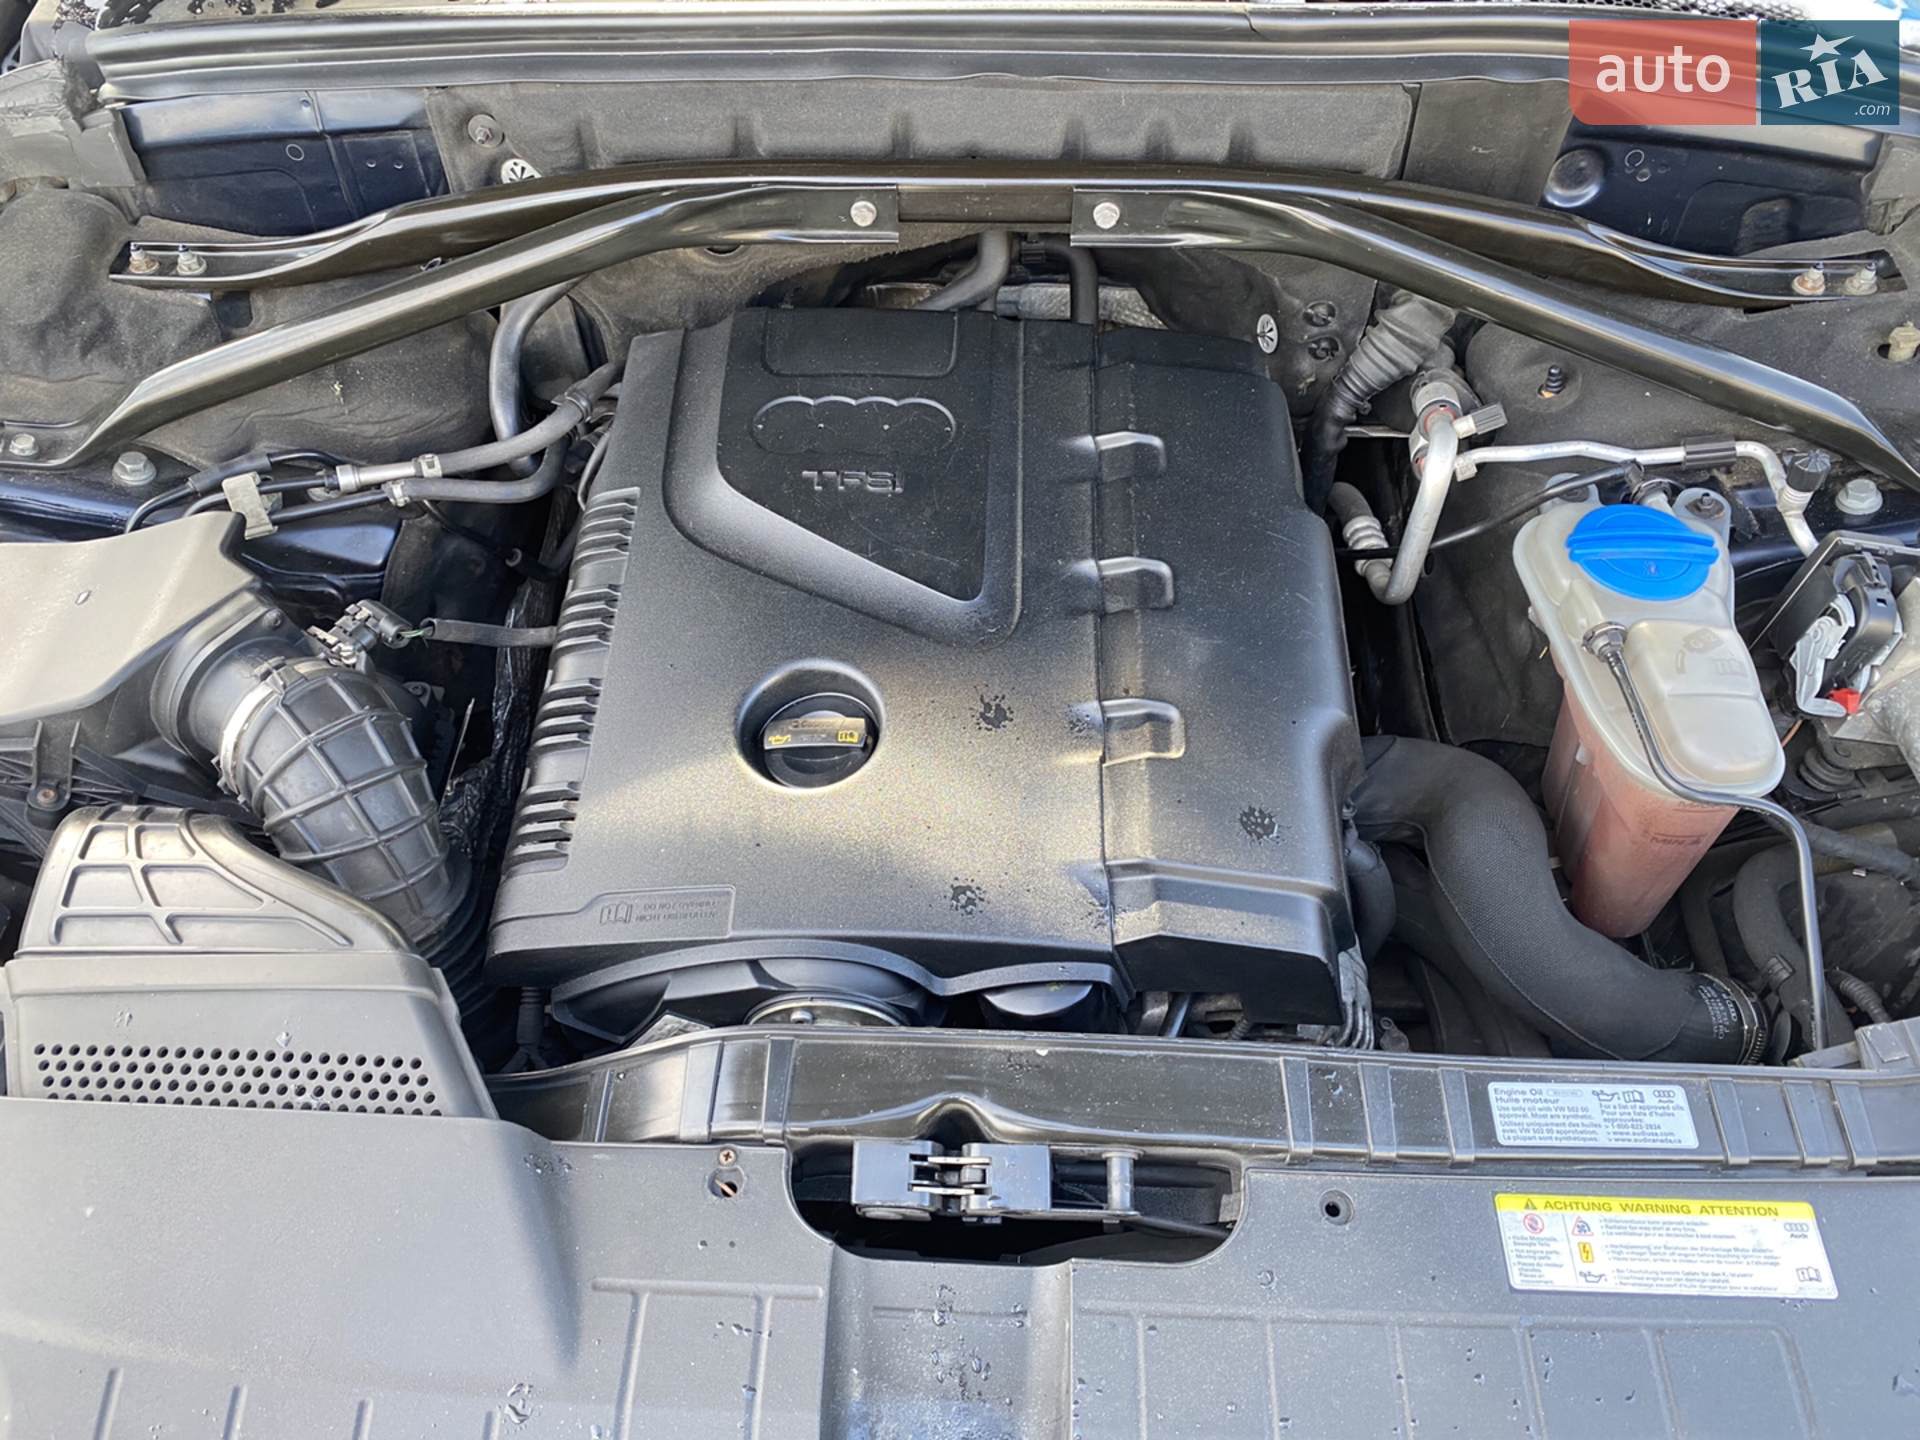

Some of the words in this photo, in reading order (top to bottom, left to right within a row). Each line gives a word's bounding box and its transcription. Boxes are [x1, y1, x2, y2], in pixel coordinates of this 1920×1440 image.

[801, 469, 904, 493] TFSI
[1649, 836, 1686, 846] MIN
[1494, 1088, 1527, 1097] Engine
[1529, 1088, 1543, 1096] Oil
[1495, 1096, 1521, 1104] Huile
[1522, 1097, 1560, 1105] moteur
[1511, 1105, 1526, 1113] only
[1638, 1104, 1670, 1112] approved
[1544, 1200, 1613, 1212] ACHTUNG
[1619, 1203, 1691, 1214] WARNING
[1699, 1205, 1779, 1216] ATTENTION
